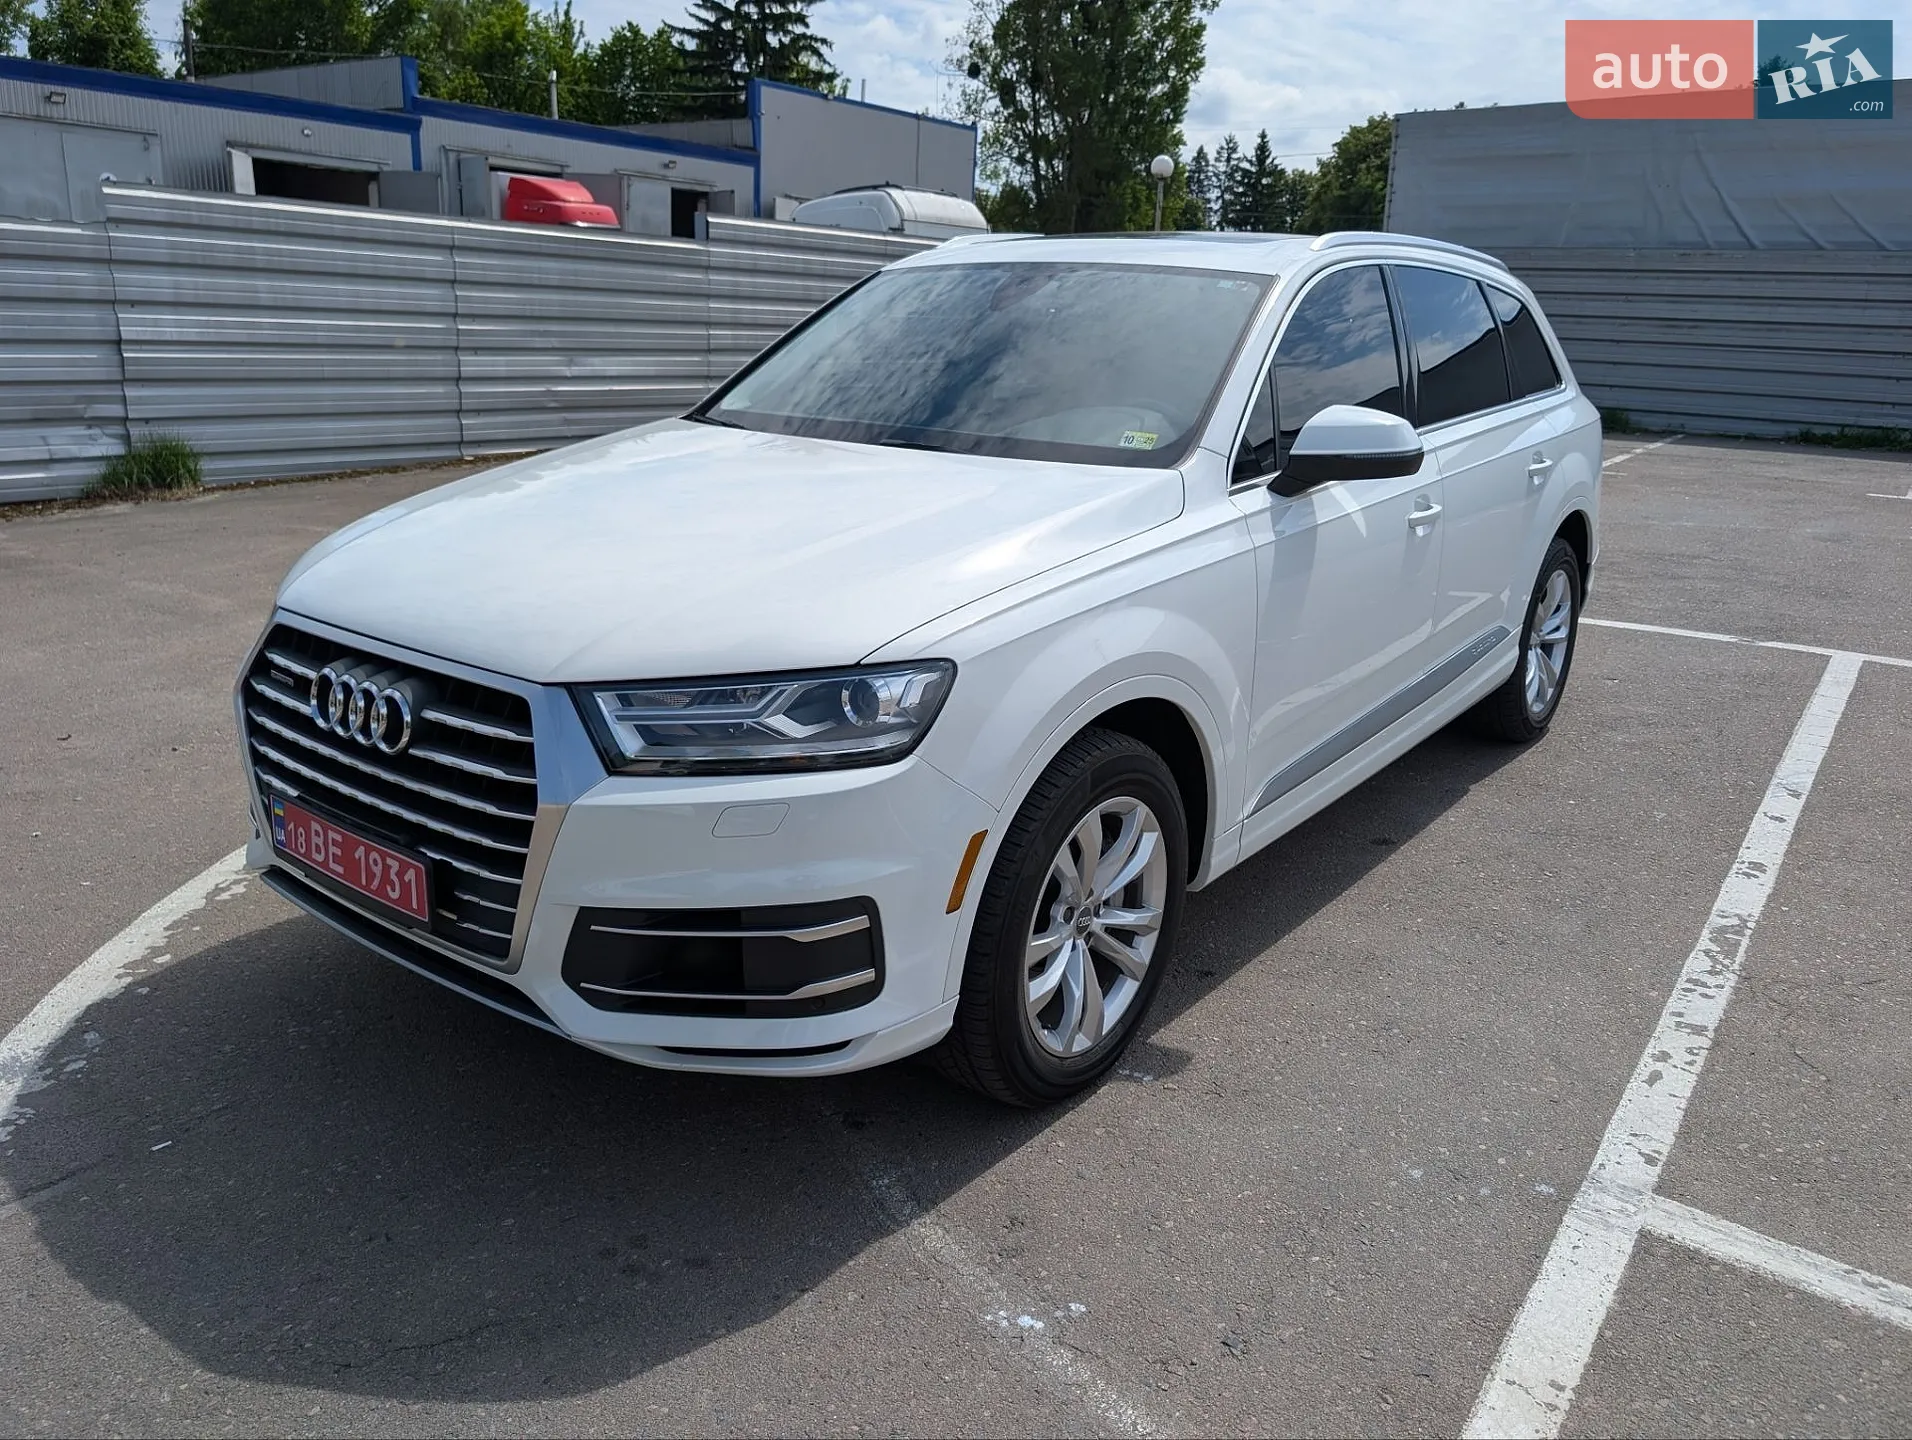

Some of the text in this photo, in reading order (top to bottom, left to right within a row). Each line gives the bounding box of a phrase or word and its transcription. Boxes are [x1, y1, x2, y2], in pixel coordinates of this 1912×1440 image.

[275, 826, 286, 844] UA
[287, 820, 418, 910] 18 BE 1931
